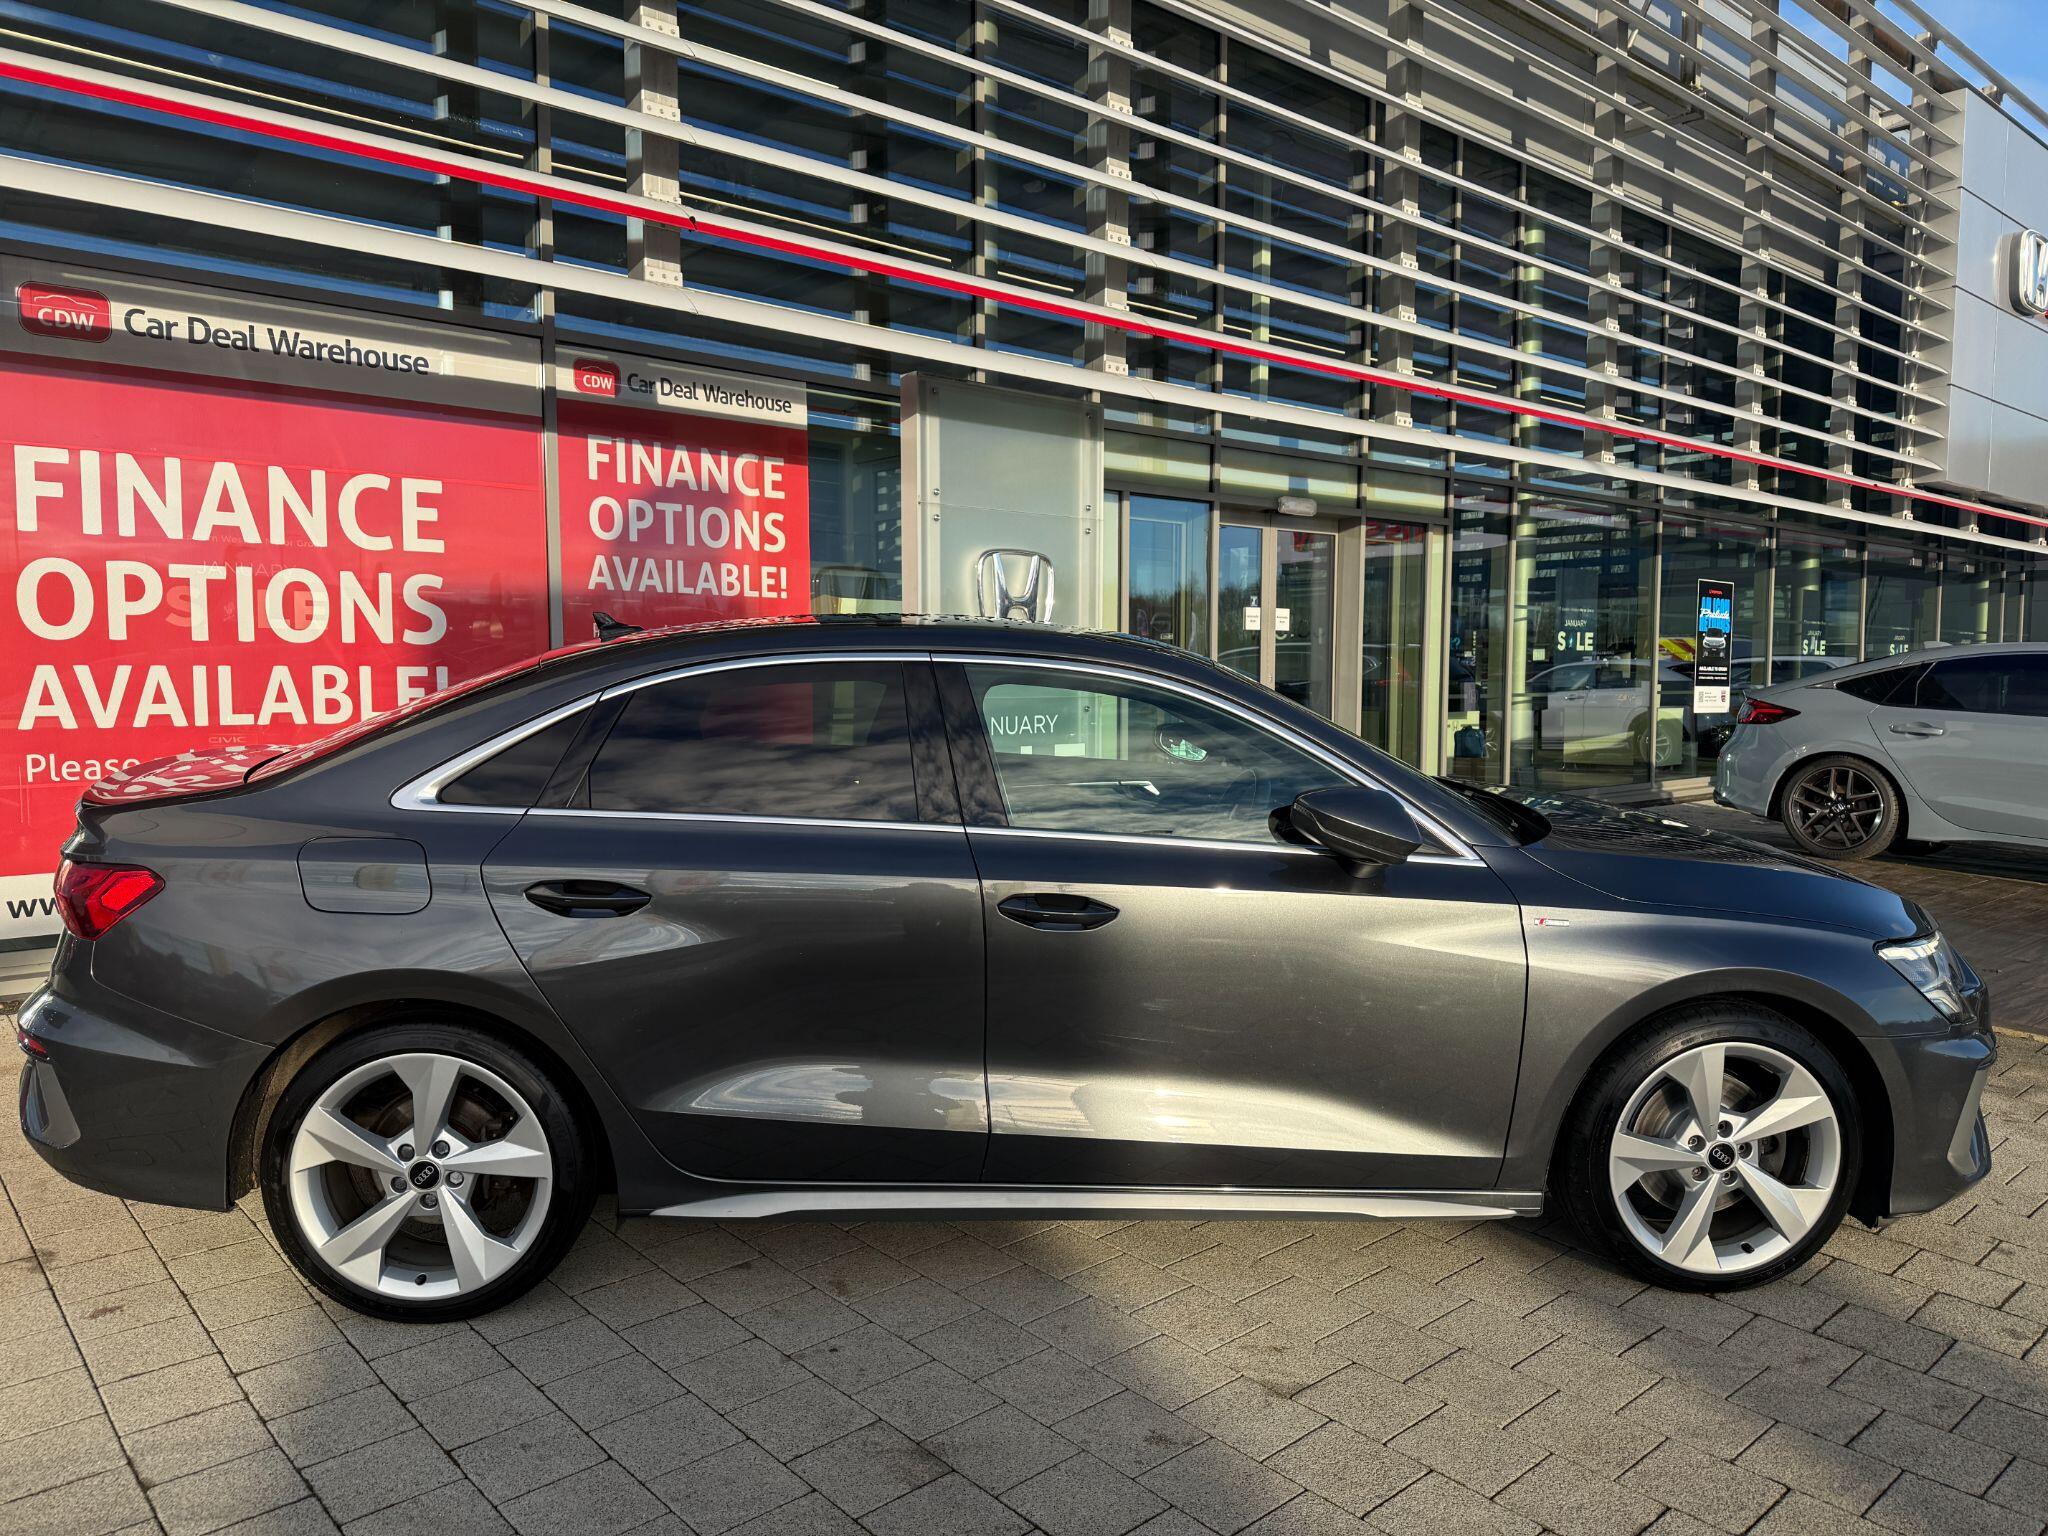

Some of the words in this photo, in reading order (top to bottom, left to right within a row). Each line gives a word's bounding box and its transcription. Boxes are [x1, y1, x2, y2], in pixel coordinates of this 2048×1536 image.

[37, 307, 95, 332] CDW
[123, 308, 179, 341] Car
[187, 317, 259, 353] Deal
[266, 328, 430, 375] Warehouse
[582, 374, 612, 390] CDW
[627, 373, 657, 394] Car
[660, 377, 699, 401] Deal
[702, 384, 792, 414] Warehouse
[587, 434, 786, 500] FINANCE
[14, 445, 445, 553] FINANCE
[588, 495, 786, 553] OPTIONS
[587, 554, 788, 599] AVAILABLE!
[16, 557, 447, 645] OPTIONS
[1557, 631, 1594, 651] SLE
[1803, 639, 1826, 655] SLE
[991, 714, 1058, 735] NUARY
[26, 753, 140, 783] Pleas
